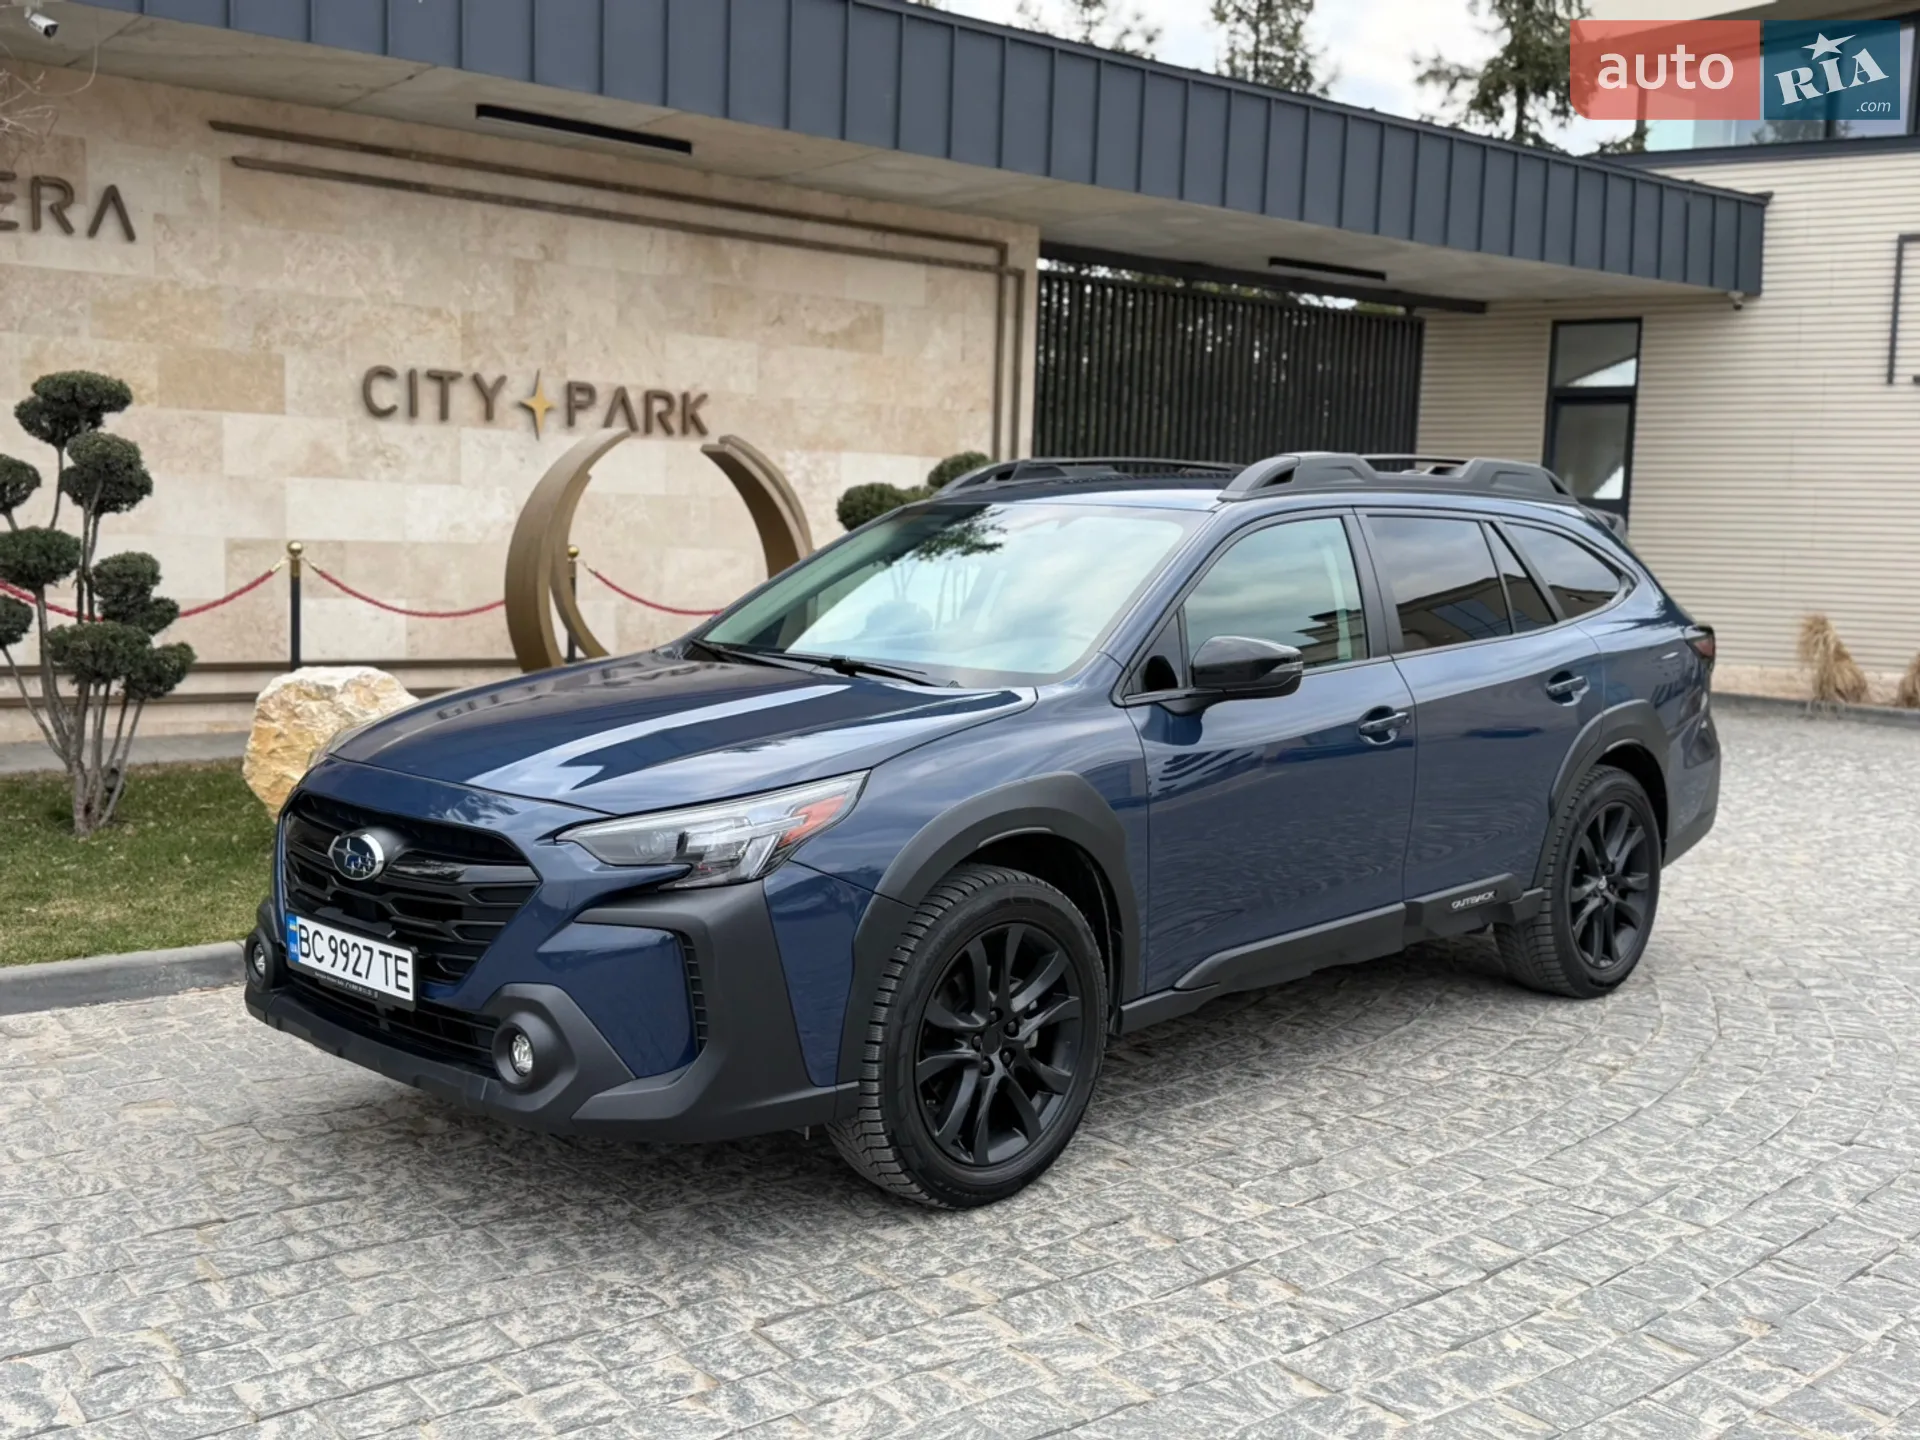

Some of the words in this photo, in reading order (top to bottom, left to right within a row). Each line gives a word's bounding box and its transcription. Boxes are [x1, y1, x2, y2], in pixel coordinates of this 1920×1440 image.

[362, 365, 508, 422] CITY
[566, 381, 709, 436] PARK
[1451, 890, 1497, 909] OUTBACK
[299, 924, 325, 963] BC
[328, 935, 374, 980] 9927
[378, 950, 410, 993] TE
